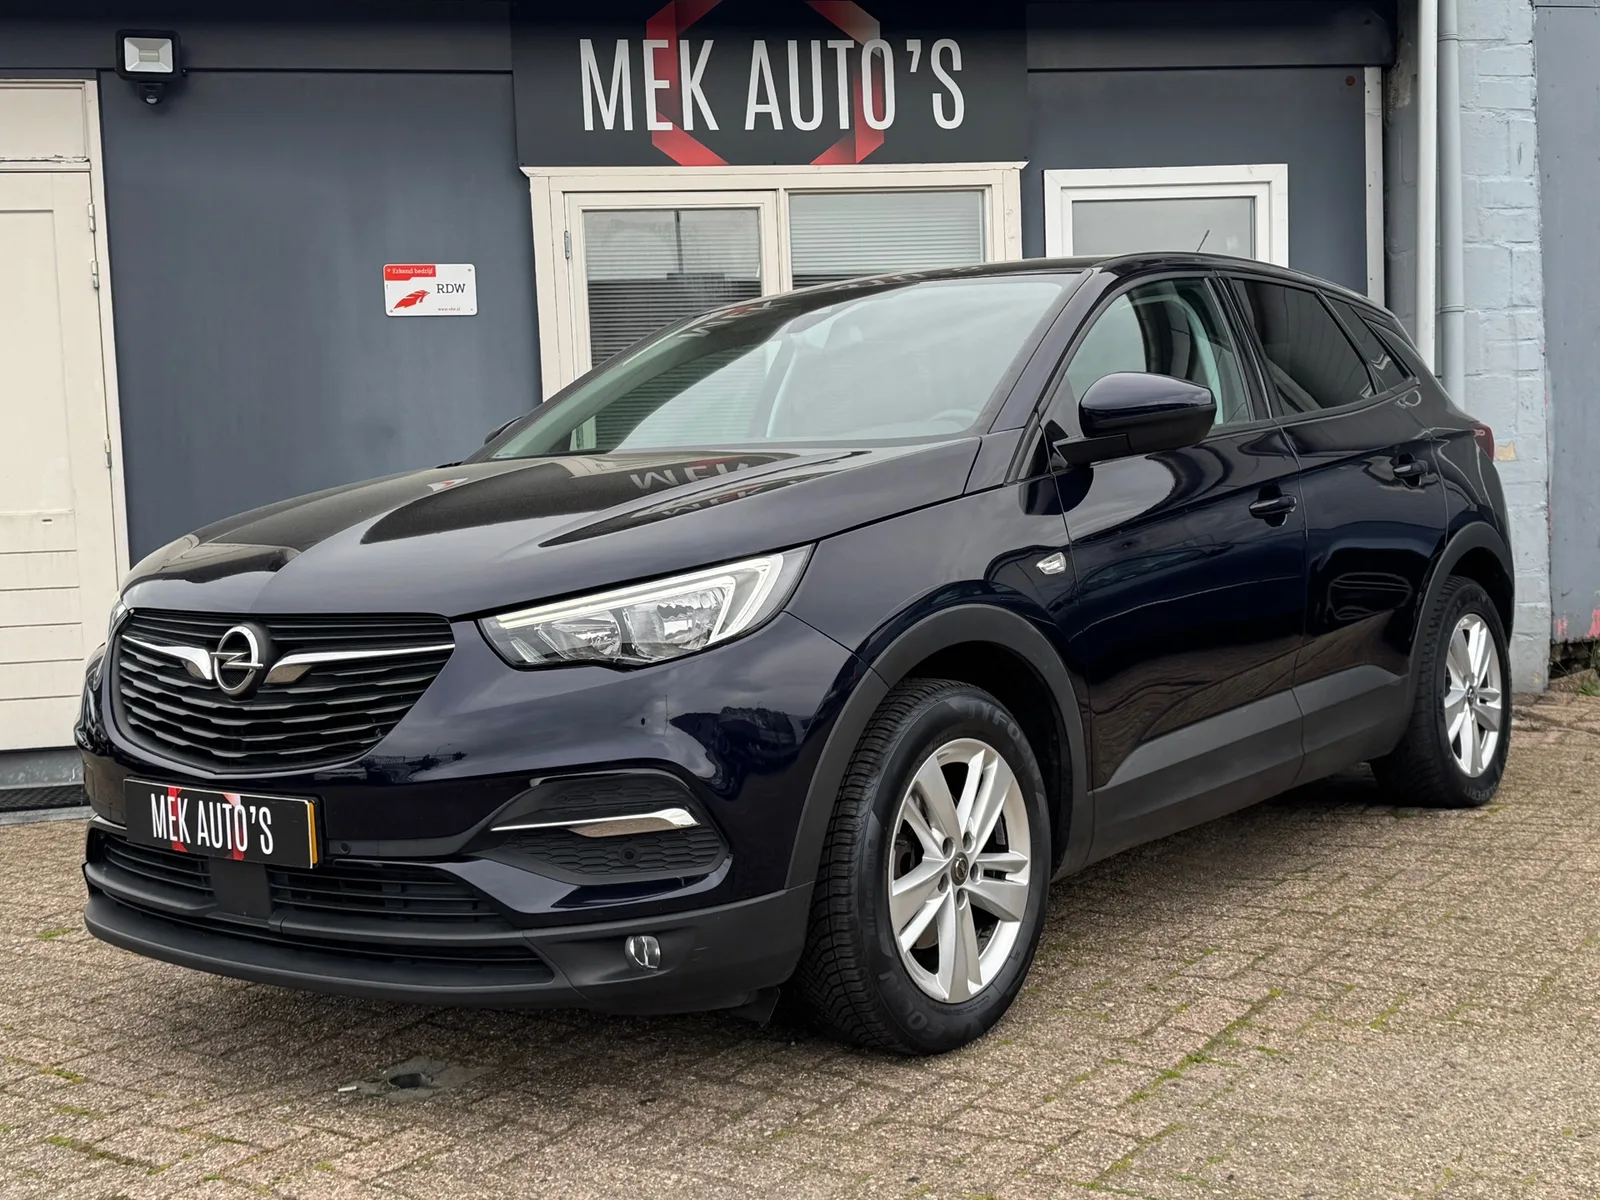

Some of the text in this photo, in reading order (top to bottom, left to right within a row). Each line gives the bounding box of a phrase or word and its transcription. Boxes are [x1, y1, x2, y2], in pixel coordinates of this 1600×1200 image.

[580, 38, 965, 131] MEK AUTO'S
[436, 283, 466, 294] RDW
[151, 793, 274, 855] MEK AUTO'S
